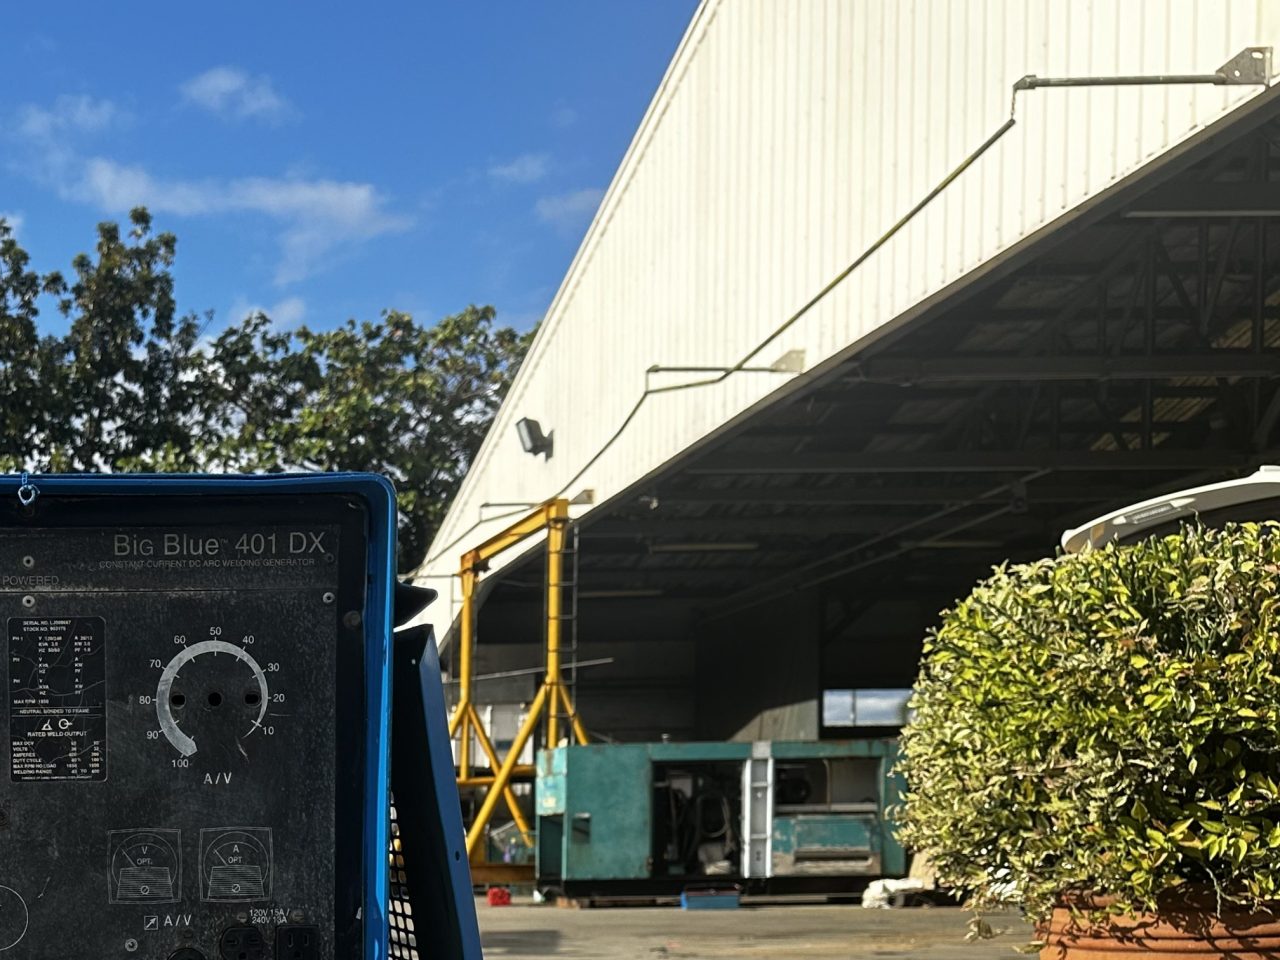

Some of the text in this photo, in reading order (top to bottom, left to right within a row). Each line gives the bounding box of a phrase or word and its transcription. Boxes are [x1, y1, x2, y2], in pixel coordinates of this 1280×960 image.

[235, 533, 276, 555] 401
[289, 532, 325, 554] DX
[99, 558, 315, 569] CONSTANT CURRENT DC ARC WELDING GENERATOR
[2, 575, 60, 586] POWERED
[209, 627, 222, 636] 50
[173, 635, 186, 644] 60
[242, 635, 255, 644] 40
[149, 659, 162, 668] 70
[267, 662, 280, 671] 30
[139, 695, 151, 704] 80
[272, 694, 285, 703] 20
[146, 730, 159, 739] 90
[263, 726, 275, 735] 10
[171, 759, 188, 768] 100
[141, 846, 148, 854] V
[233, 844, 240, 853] A
[250, 908, 269, 917] 120V
[271, 908, 285, 917] 15A
[252, 916, 271, 924] 240V
